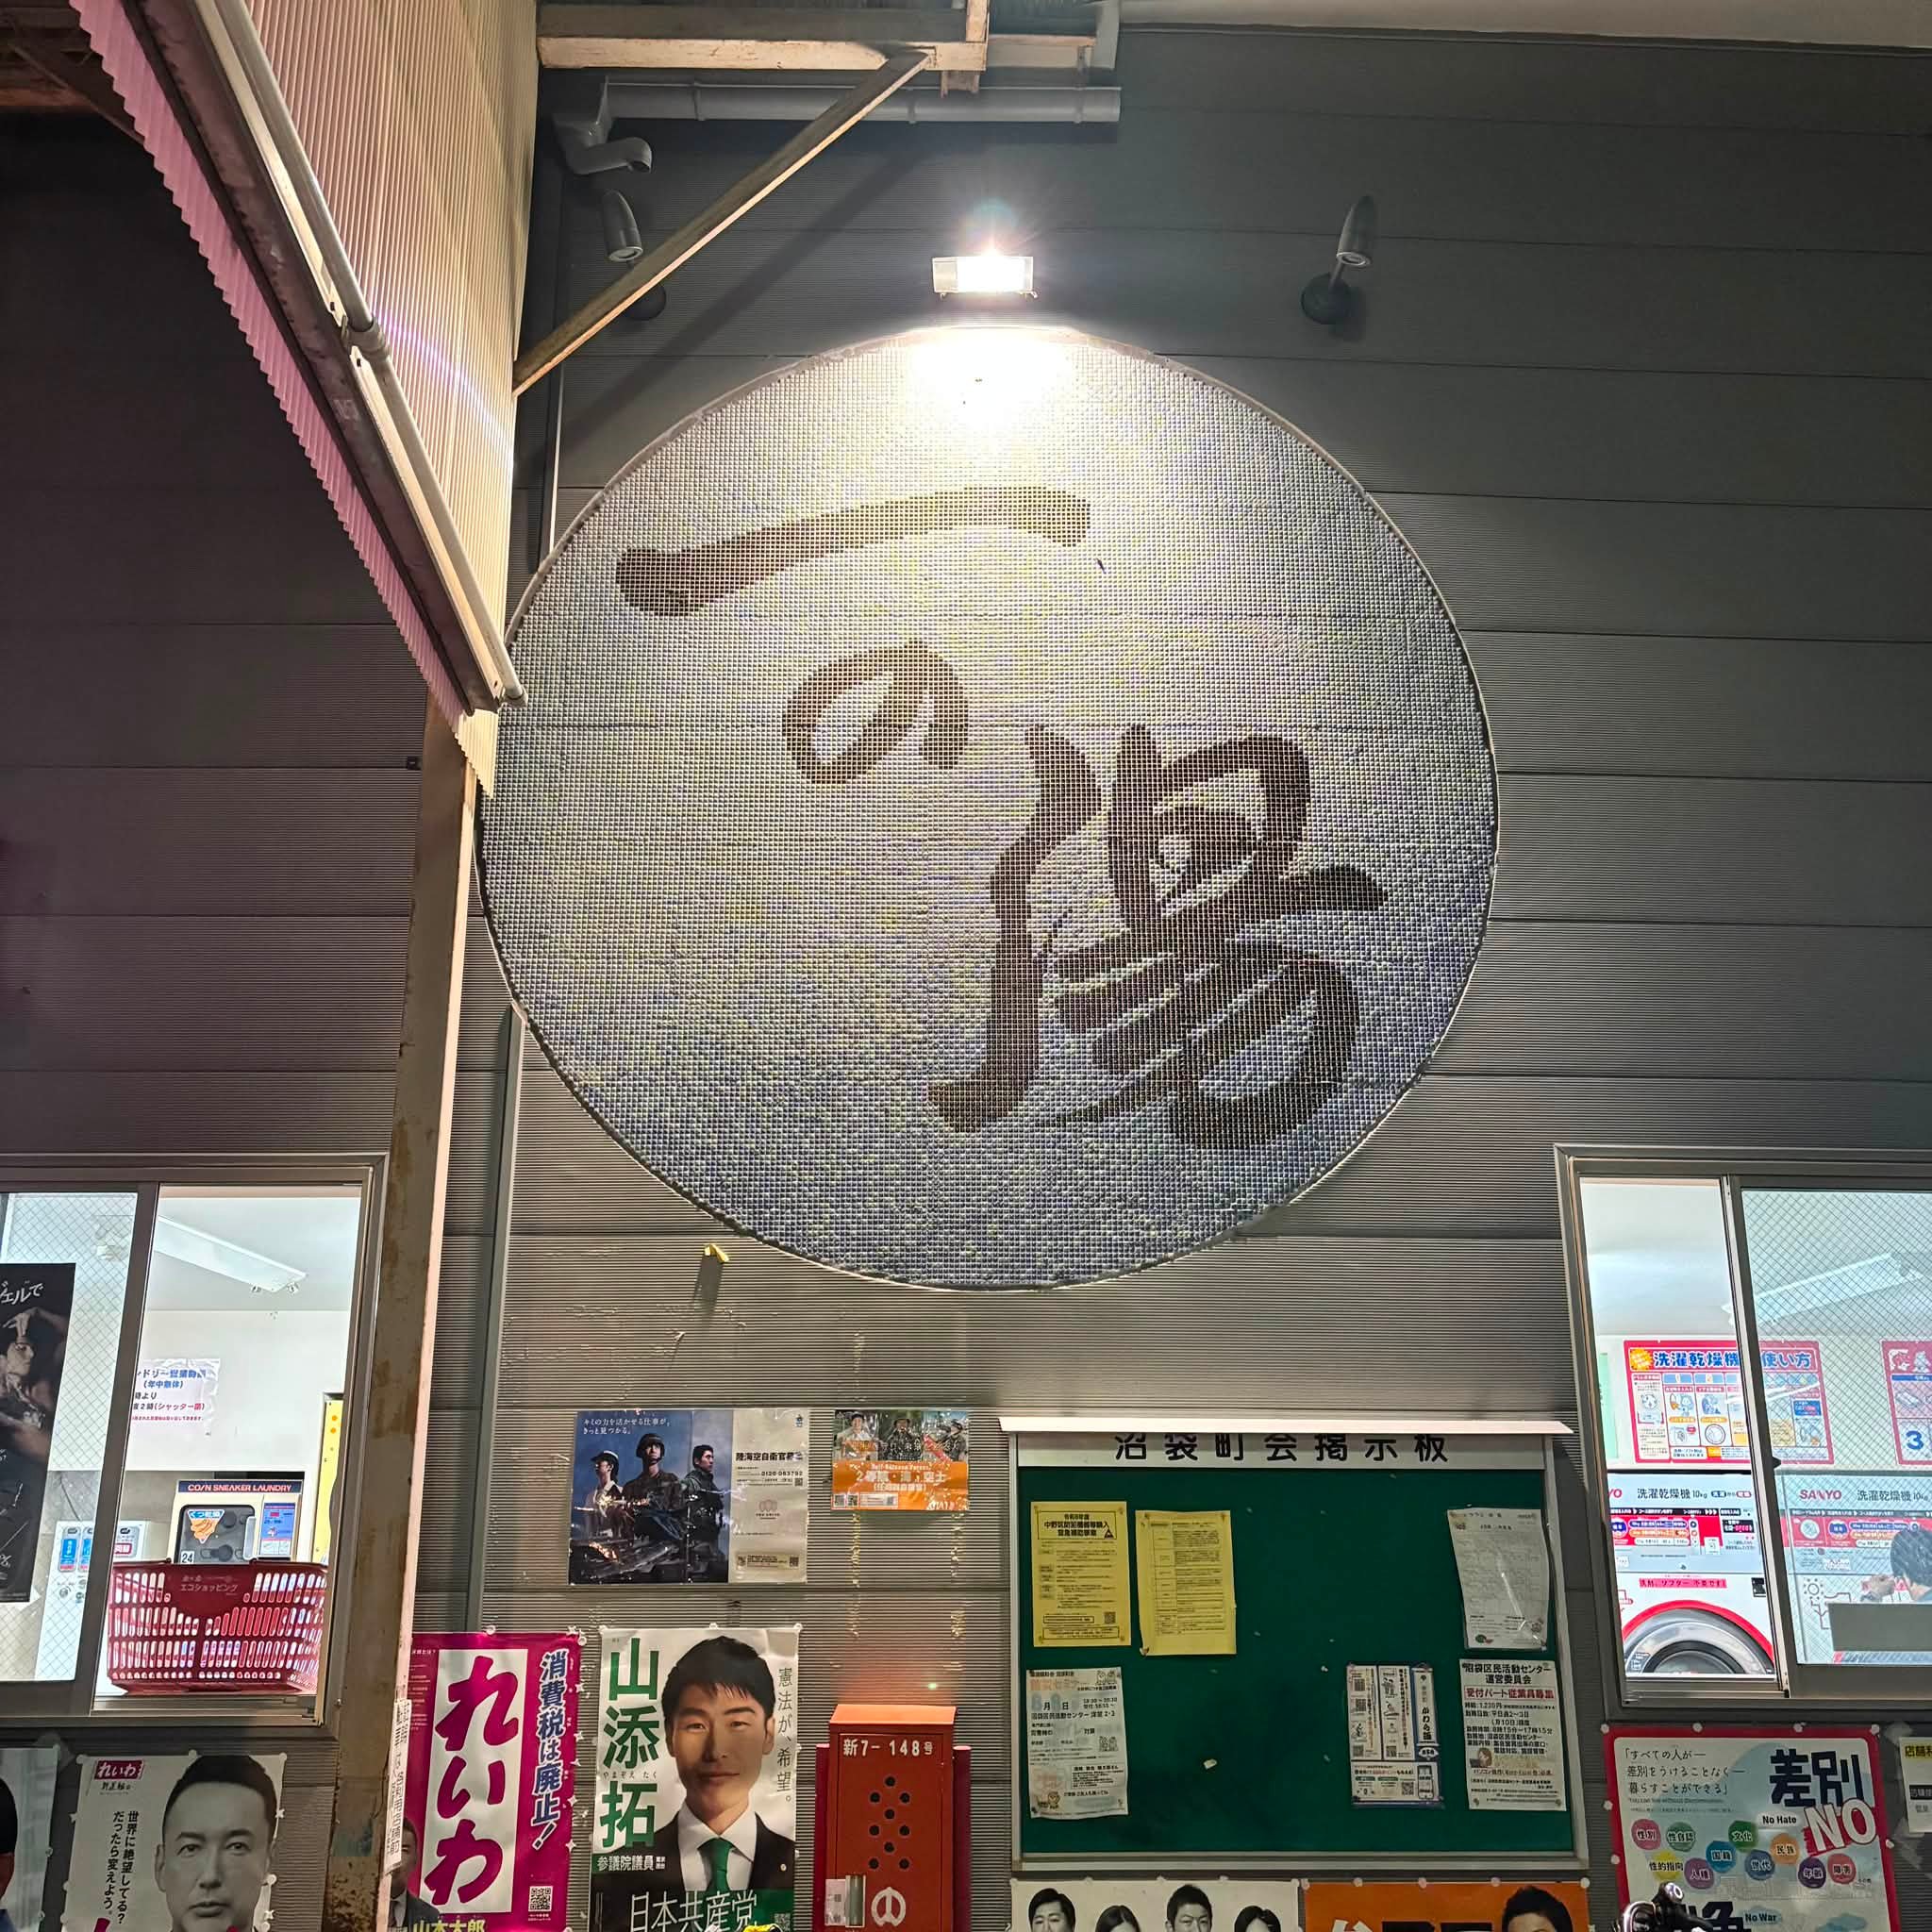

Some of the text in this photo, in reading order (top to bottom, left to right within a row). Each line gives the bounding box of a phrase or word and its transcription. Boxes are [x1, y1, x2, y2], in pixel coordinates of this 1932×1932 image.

[1114, 1433, 1448, 1461] 沼袋町会掲示板
[1906, 1430, 1924, 1450] 3
[213, 1484, 251, 1492] SNEAKER
[253, 1484, 292, 1492] LAUNDRY
[1637, 1488, 1690, 1499] 洗濯乾燥機
[1800, 1490, 1842, 1500] SANYO
[182, 1552, 193, 1563] 24
[530, 1648, 569, 1851] 消費税は廃止!
[600, 1636, 660, 1849] 山添拓
[775, 1667, 794, 1802] 憲法が、希望。
[97, 1761, 138, 1778] れいわ
[424, 1655, 519, 1906] れいわ
[1769, 1748, 1865, 1807] 差別
[1762, 1816, 1797, 1824] No Hate
[1804, 1797, 1877, 1852] NO
[103, 1810, 125, 1915] だったら変えよう。
[117, 1810, 140, 1924] 世界に絶望してる?
[597, 1855, 654, 1872] 参議院議員
[630, 1889, 758, 1932] 日本共産党
